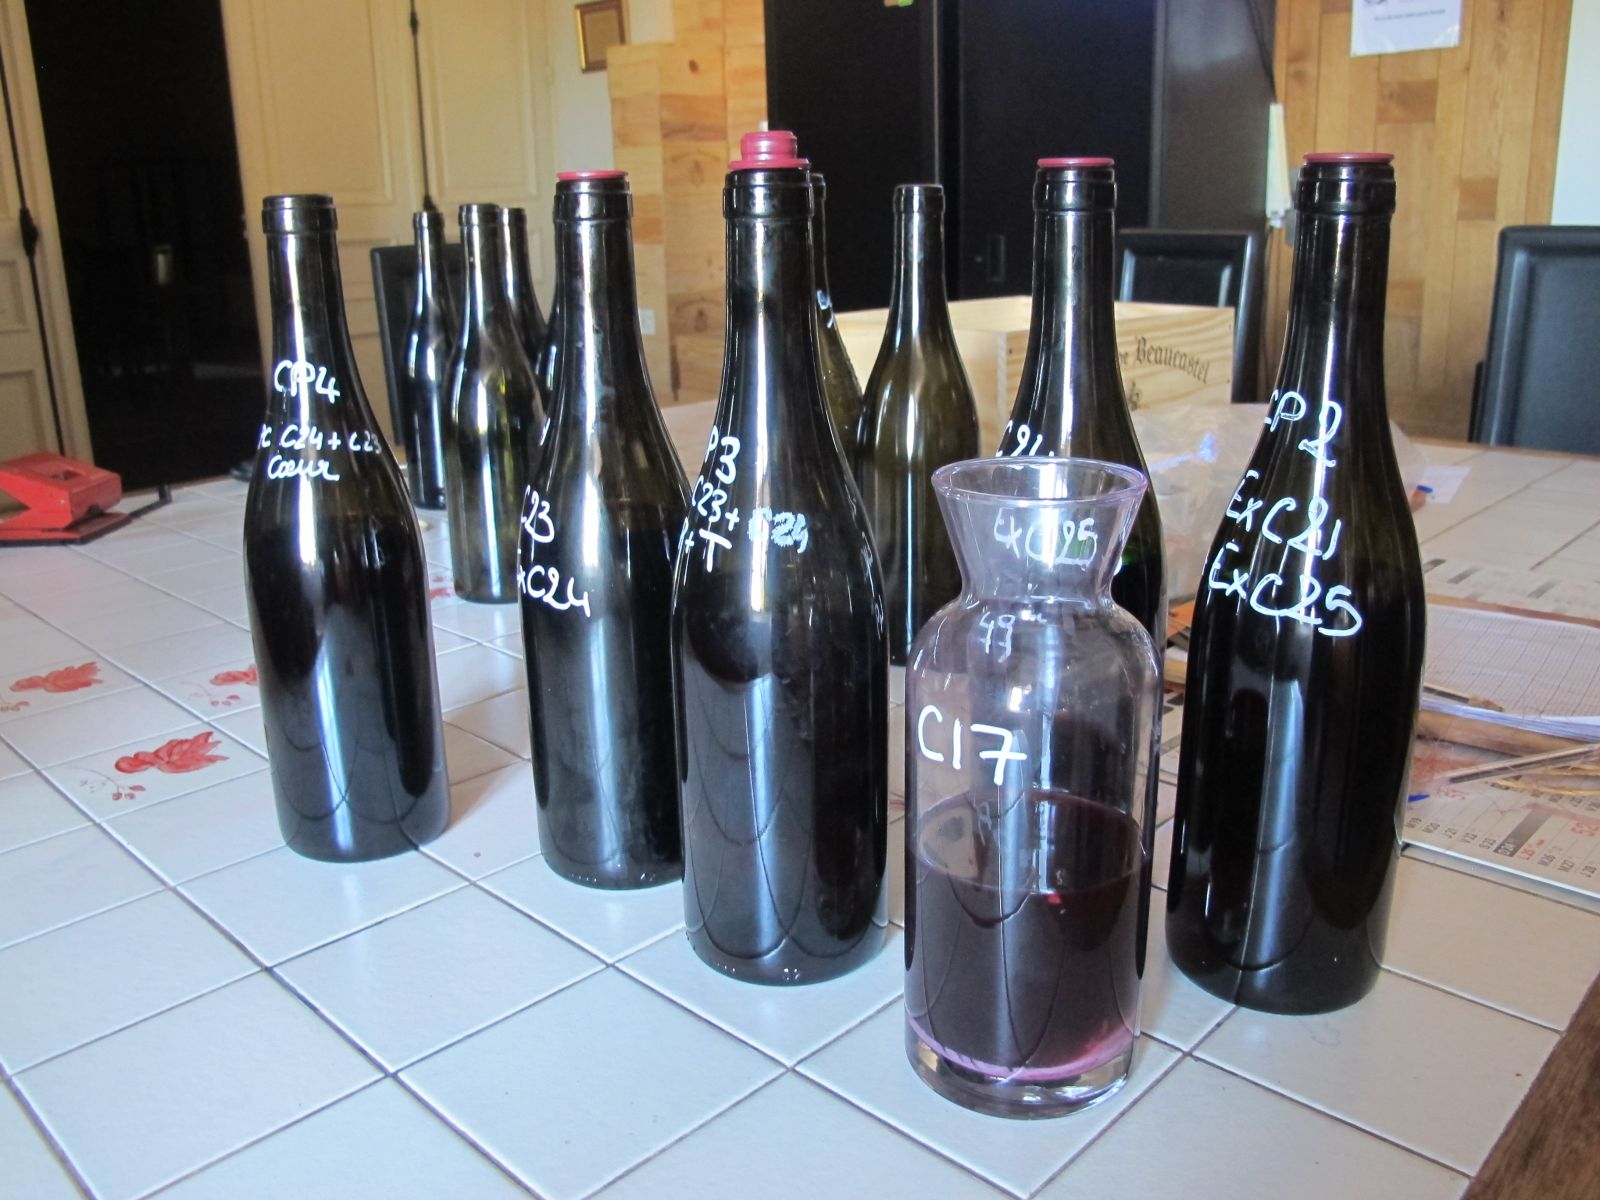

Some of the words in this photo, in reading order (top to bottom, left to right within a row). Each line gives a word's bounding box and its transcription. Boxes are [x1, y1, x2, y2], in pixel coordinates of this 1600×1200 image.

[274, 360, 341, 403] CP4
[1135, 335, 1210, 384] Beaucastel
[918, 704, 1028, 786] C17
